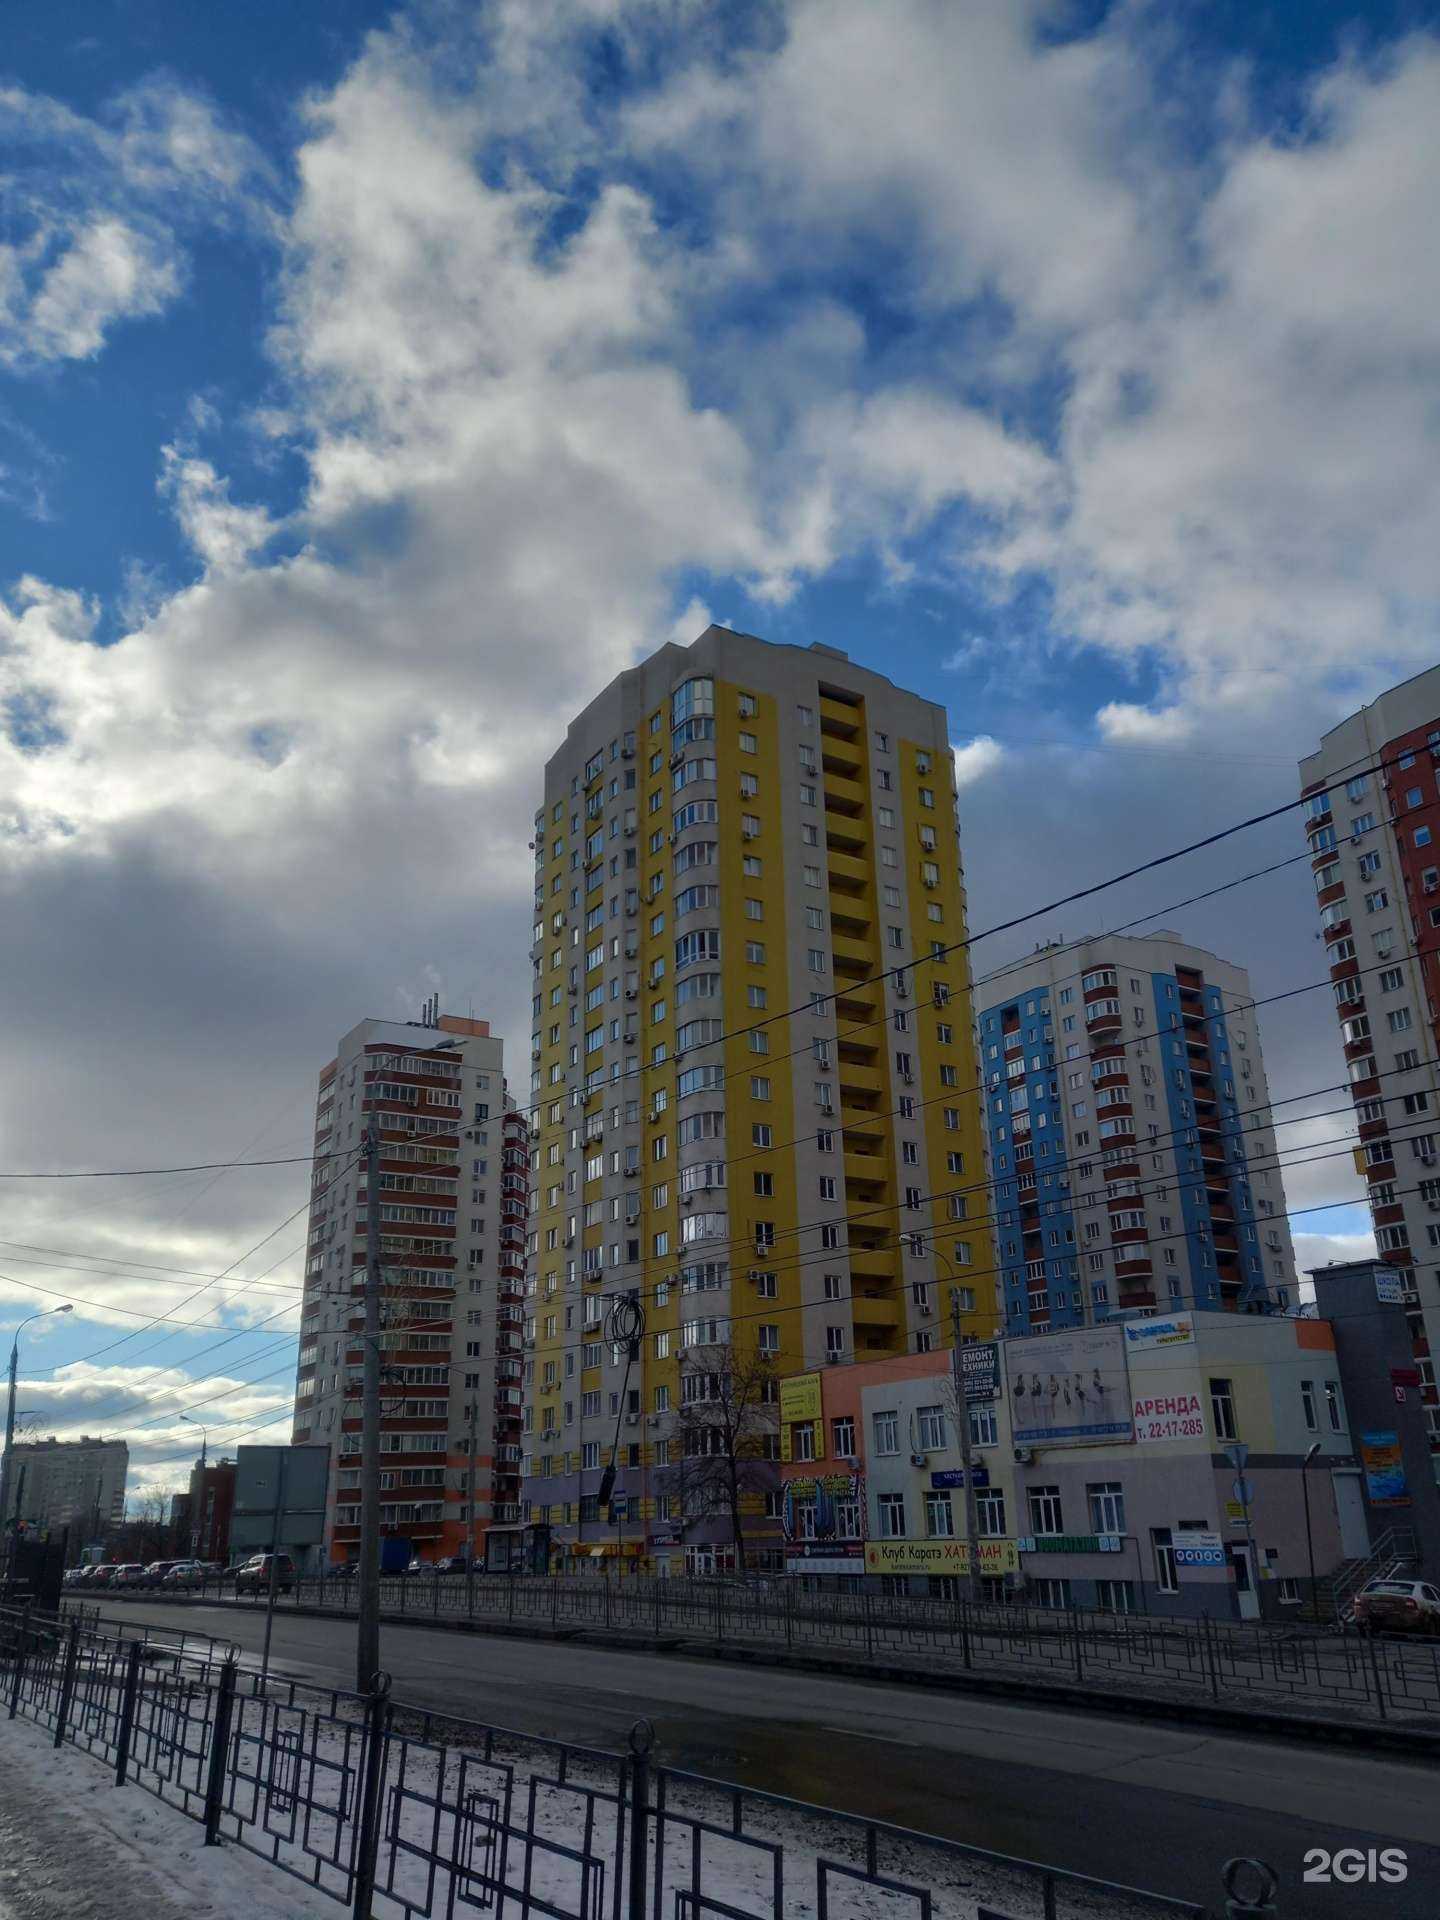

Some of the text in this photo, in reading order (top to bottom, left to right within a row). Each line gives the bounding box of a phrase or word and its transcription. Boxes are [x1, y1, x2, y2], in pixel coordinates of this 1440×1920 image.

[962, 1350, 994, 1363] ЕМОНТ
[962, 1360, 995, 1372] ЕХНИКИ
[1135, 1396, 1201, 1417] АРЕНДА
[1137, 1427, 1146, 1439] т.
[881, 1545, 905, 1562] Клуб
[908, 1546, 942, 1562] Каратэ
[944, 1545, 1002, 1559] ХАТМАН
